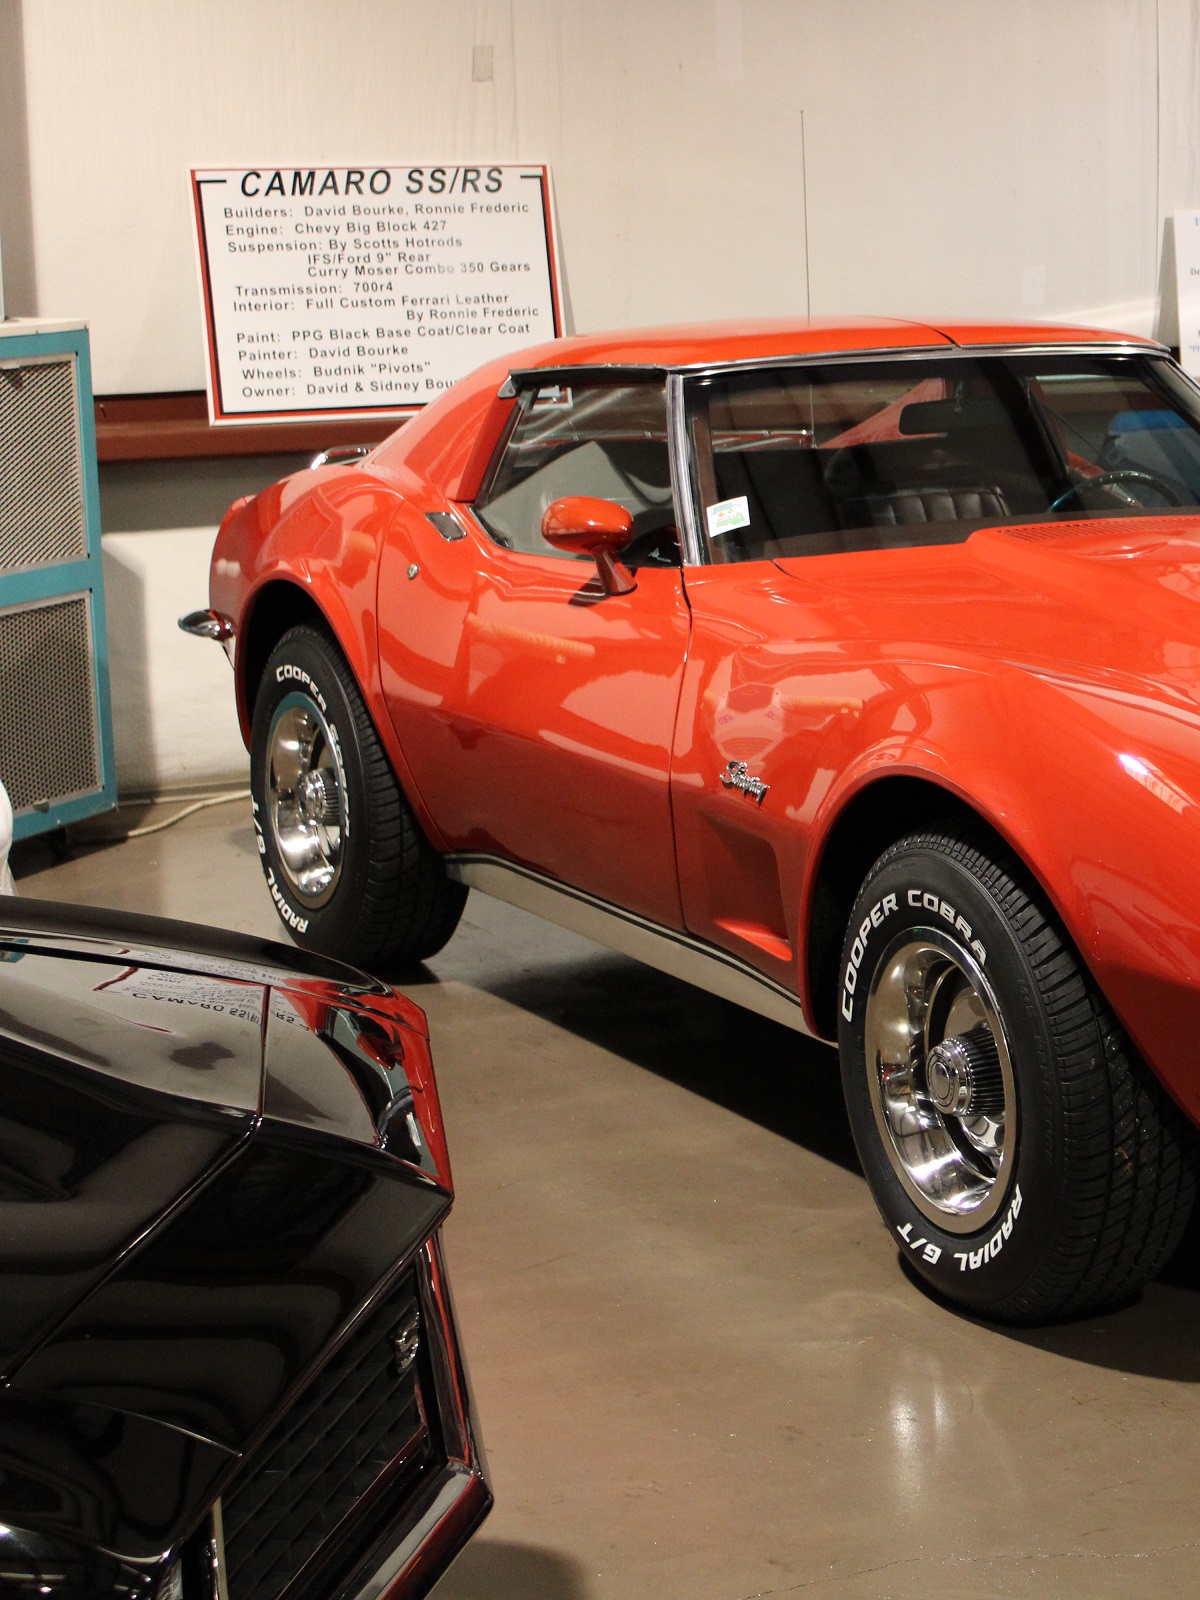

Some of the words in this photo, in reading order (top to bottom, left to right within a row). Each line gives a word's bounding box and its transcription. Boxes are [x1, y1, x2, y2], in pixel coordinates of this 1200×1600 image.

[241, 169, 391, 197] CAMARO
[406, 167, 502, 194] SS/RS
[224, 207, 292, 218] Builders:
[305, 206, 345, 216] David
[353, 205, 408, 215] Bourke,
[415, 204, 464, 214] Ronnie
[471, 203, 528, 213] Frederic
[226, 225, 282, 237] Engine:
[295, 224, 340, 235] Chevy
[347, 222, 370, 235] Big
[377, 221, 416, 232] Block
[424, 221, 446, 231] 427
[228, 240, 321, 252] Suspension:
[329, 240, 346, 252] By
[354, 239, 399, 249] Scotts
[406, 237, 462, 247] Hotrods
[308, 253, 370, 266] IFS/Ford
[377, 253, 391, 263] 9"
[398, 252, 429, 262] Rear
[308, 267, 348, 279] Curry
[355, 265, 398, 275] Moser
[405, 264, 453, 274] Combo
[461, 262, 484, 273] 350
[490, 262, 530, 272] Gears
[236, 284, 341, 296] Transmission:
[354, 282, 392, 292] 700r4
[234, 301, 294, 311] Interior:
[306, 298, 333, 309] Full
[340, 298, 395, 308] Custom
[402, 296, 449, 306] Ferrari
[456, 293, 508, 304] Leather
[407, 310, 423, 322] By
[430, 308, 477, 319] Ronnie
[483, 307, 538, 317] Frederic
[237, 333, 279, 343] Paint:
[292, 330, 322, 341] PPG
[330, 328, 369, 339] Black
[376, 328, 410, 338] Base
[417, 325, 492, 336] Coat/Clear
[498, 323, 529, 333] Coat
[239, 350, 296, 361] Painter:
[309, 347, 350, 358] David
[357, 345, 408, 356] Bourke
[242, 368, 301, 379] Wheels:
[314, 365, 364, 376] Budnik
[371, 362, 430, 374] "Pivots"
[242, 387, 294, 397] Owner:
[307, 383, 348, 394] David
[355, 382, 363, 392] &
[371, 381, 418, 392] Sidney
[426, 378, 457, 389] Bou
[275, 664, 327, 713] COOPER
[268, 866, 309, 933] RADIAL
[842, 893, 899, 1022] COOPER
[908, 890, 987, 966] COBRA
[954, 1184, 1023, 1272] RADIAL
[896, 1222, 942, 1264] G/T
